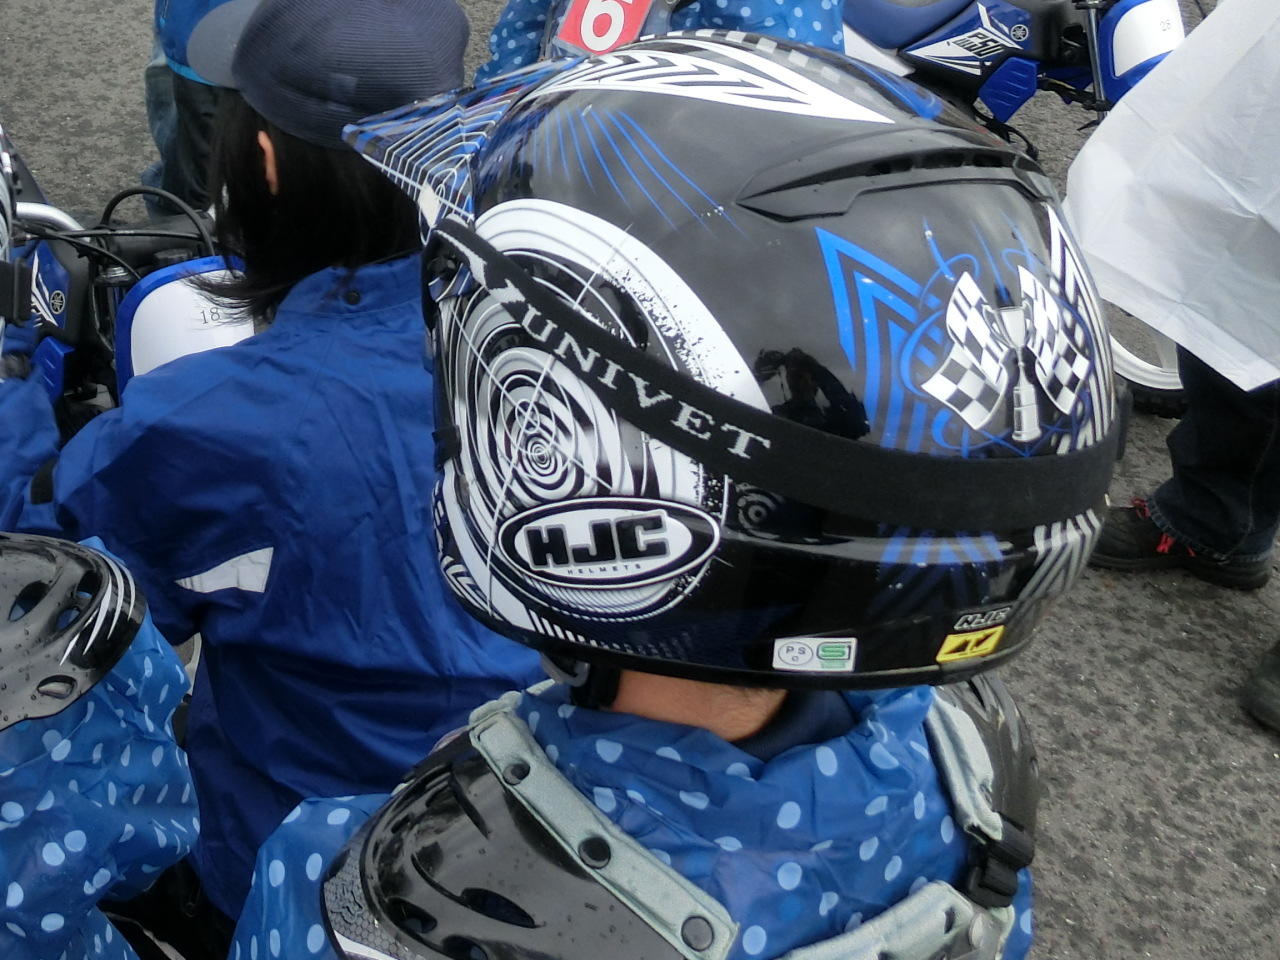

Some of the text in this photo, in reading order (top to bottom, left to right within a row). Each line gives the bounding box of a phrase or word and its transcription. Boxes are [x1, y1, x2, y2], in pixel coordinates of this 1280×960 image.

[200, 306, 220, 324] 18
[521, 303, 771, 460] UNIVET
[524, 513, 669, 568] HJC
[567, 563, 642, 575] HELMETS
